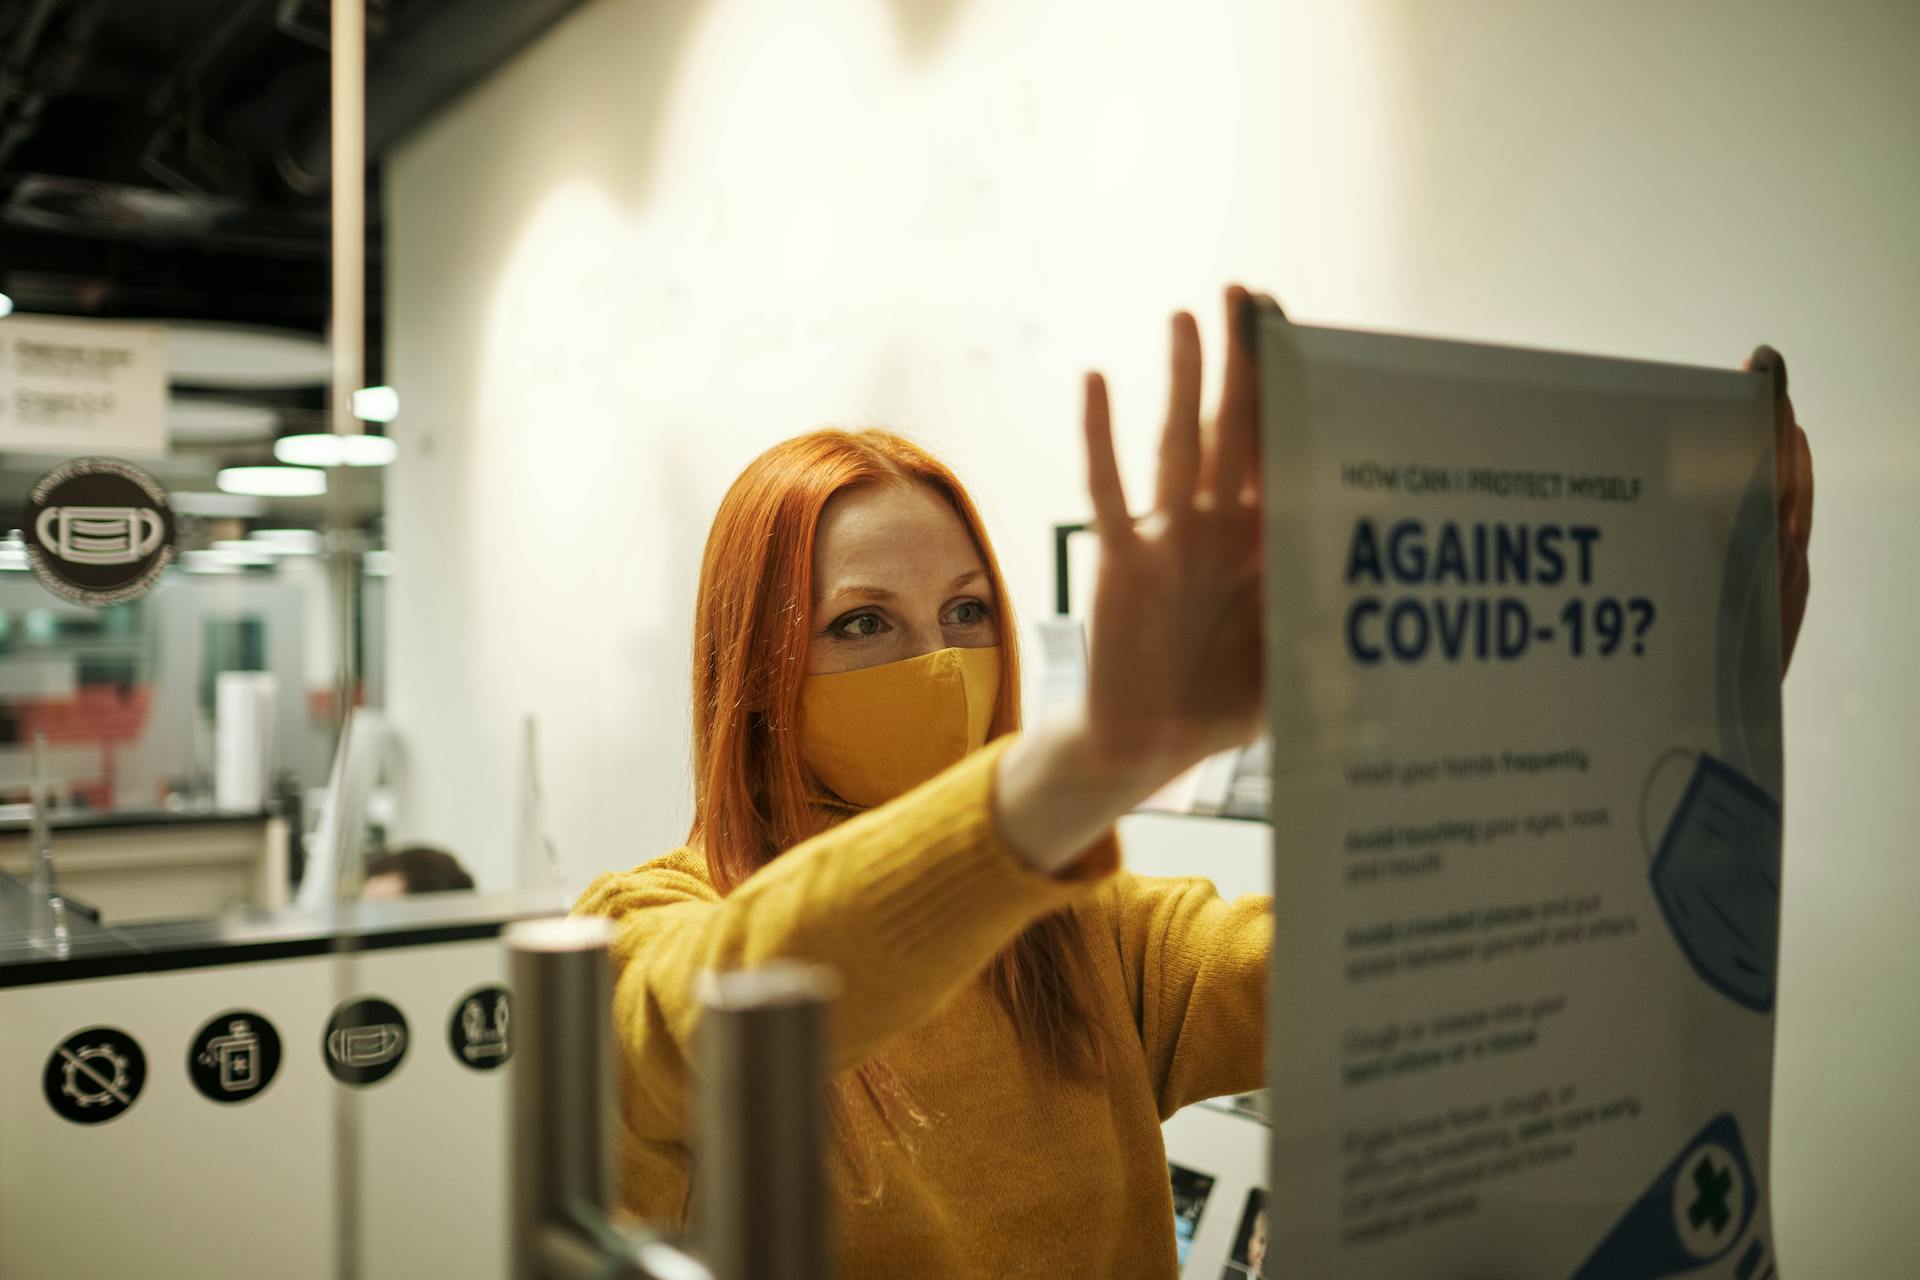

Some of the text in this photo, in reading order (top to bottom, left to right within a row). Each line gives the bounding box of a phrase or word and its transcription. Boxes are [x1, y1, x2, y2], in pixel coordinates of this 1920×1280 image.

[1341, 460, 1398, 491] HOW
[1404, 463, 1450, 492] CAN
[1466, 468, 1562, 499] PROTECT
[1568, 475, 1643, 501] MYSELF
[1346, 518, 1600, 585] AGAINST
[1346, 597, 1656, 664] COVID-19?
[1500, 748, 1590, 774] frequently
